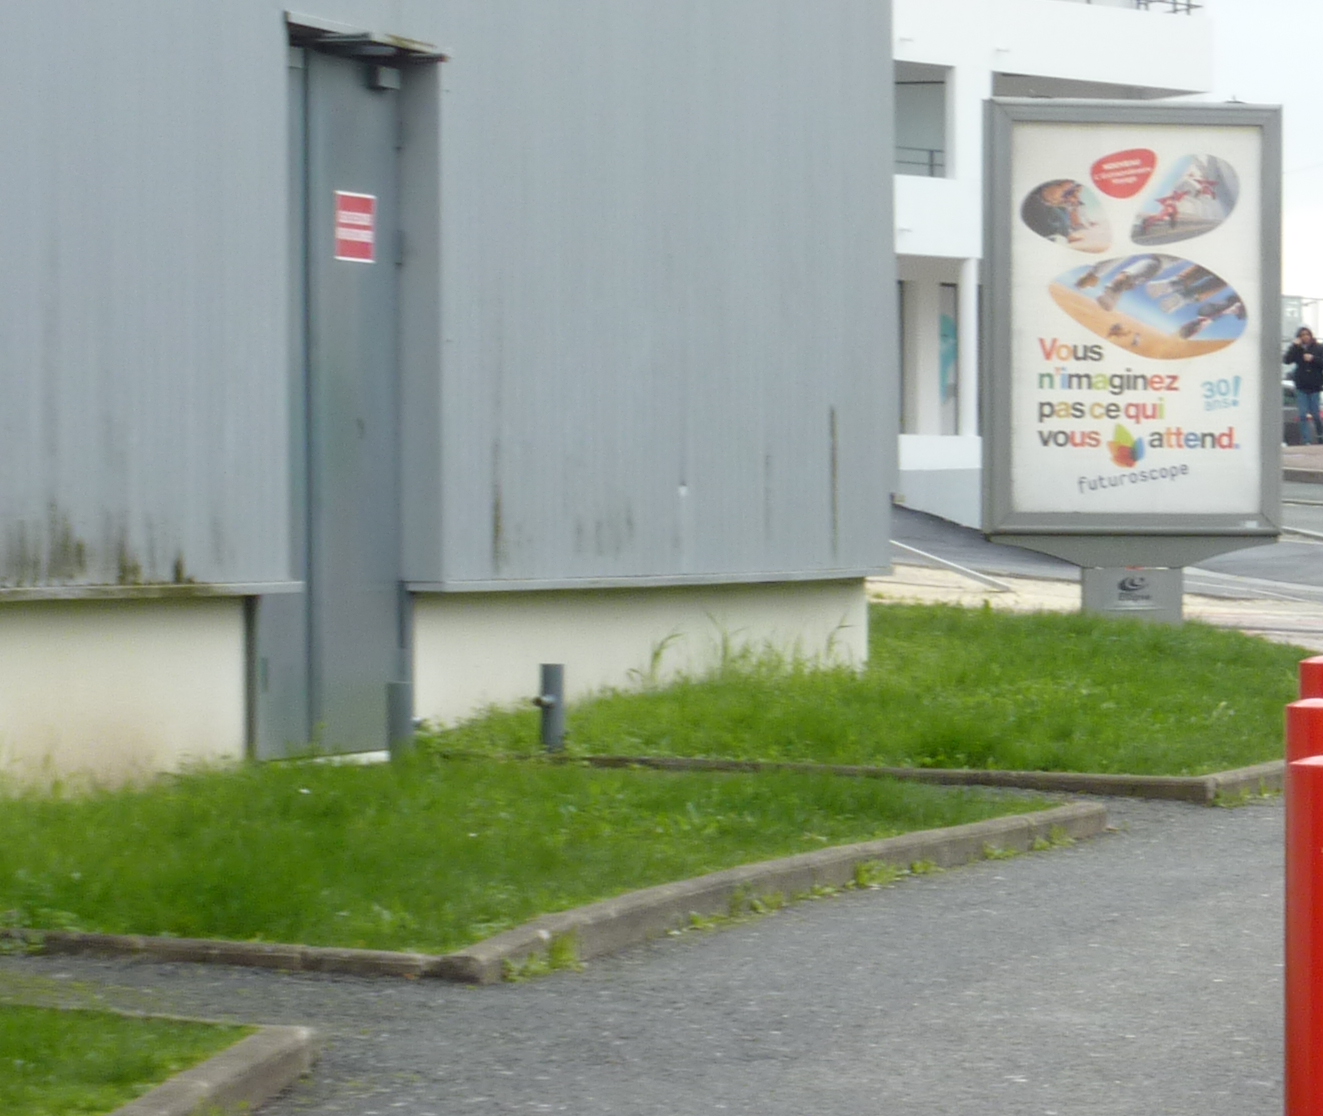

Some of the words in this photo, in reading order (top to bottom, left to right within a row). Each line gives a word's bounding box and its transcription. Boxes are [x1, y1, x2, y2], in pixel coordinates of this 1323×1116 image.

[1038, 338, 1104, 361] Vous
[1038, 367, 1180, 395] n'imaginez
[1038, 401, 1086, 423] pas
[1090, 401, 1121, 419] ce
[1125, 397, 1165, 424] qui
[1038, 429, 1102, 448] vous
[1148, 426, 1241, 449] attend.
[1077, 463, 1190, 494] futuroscope
